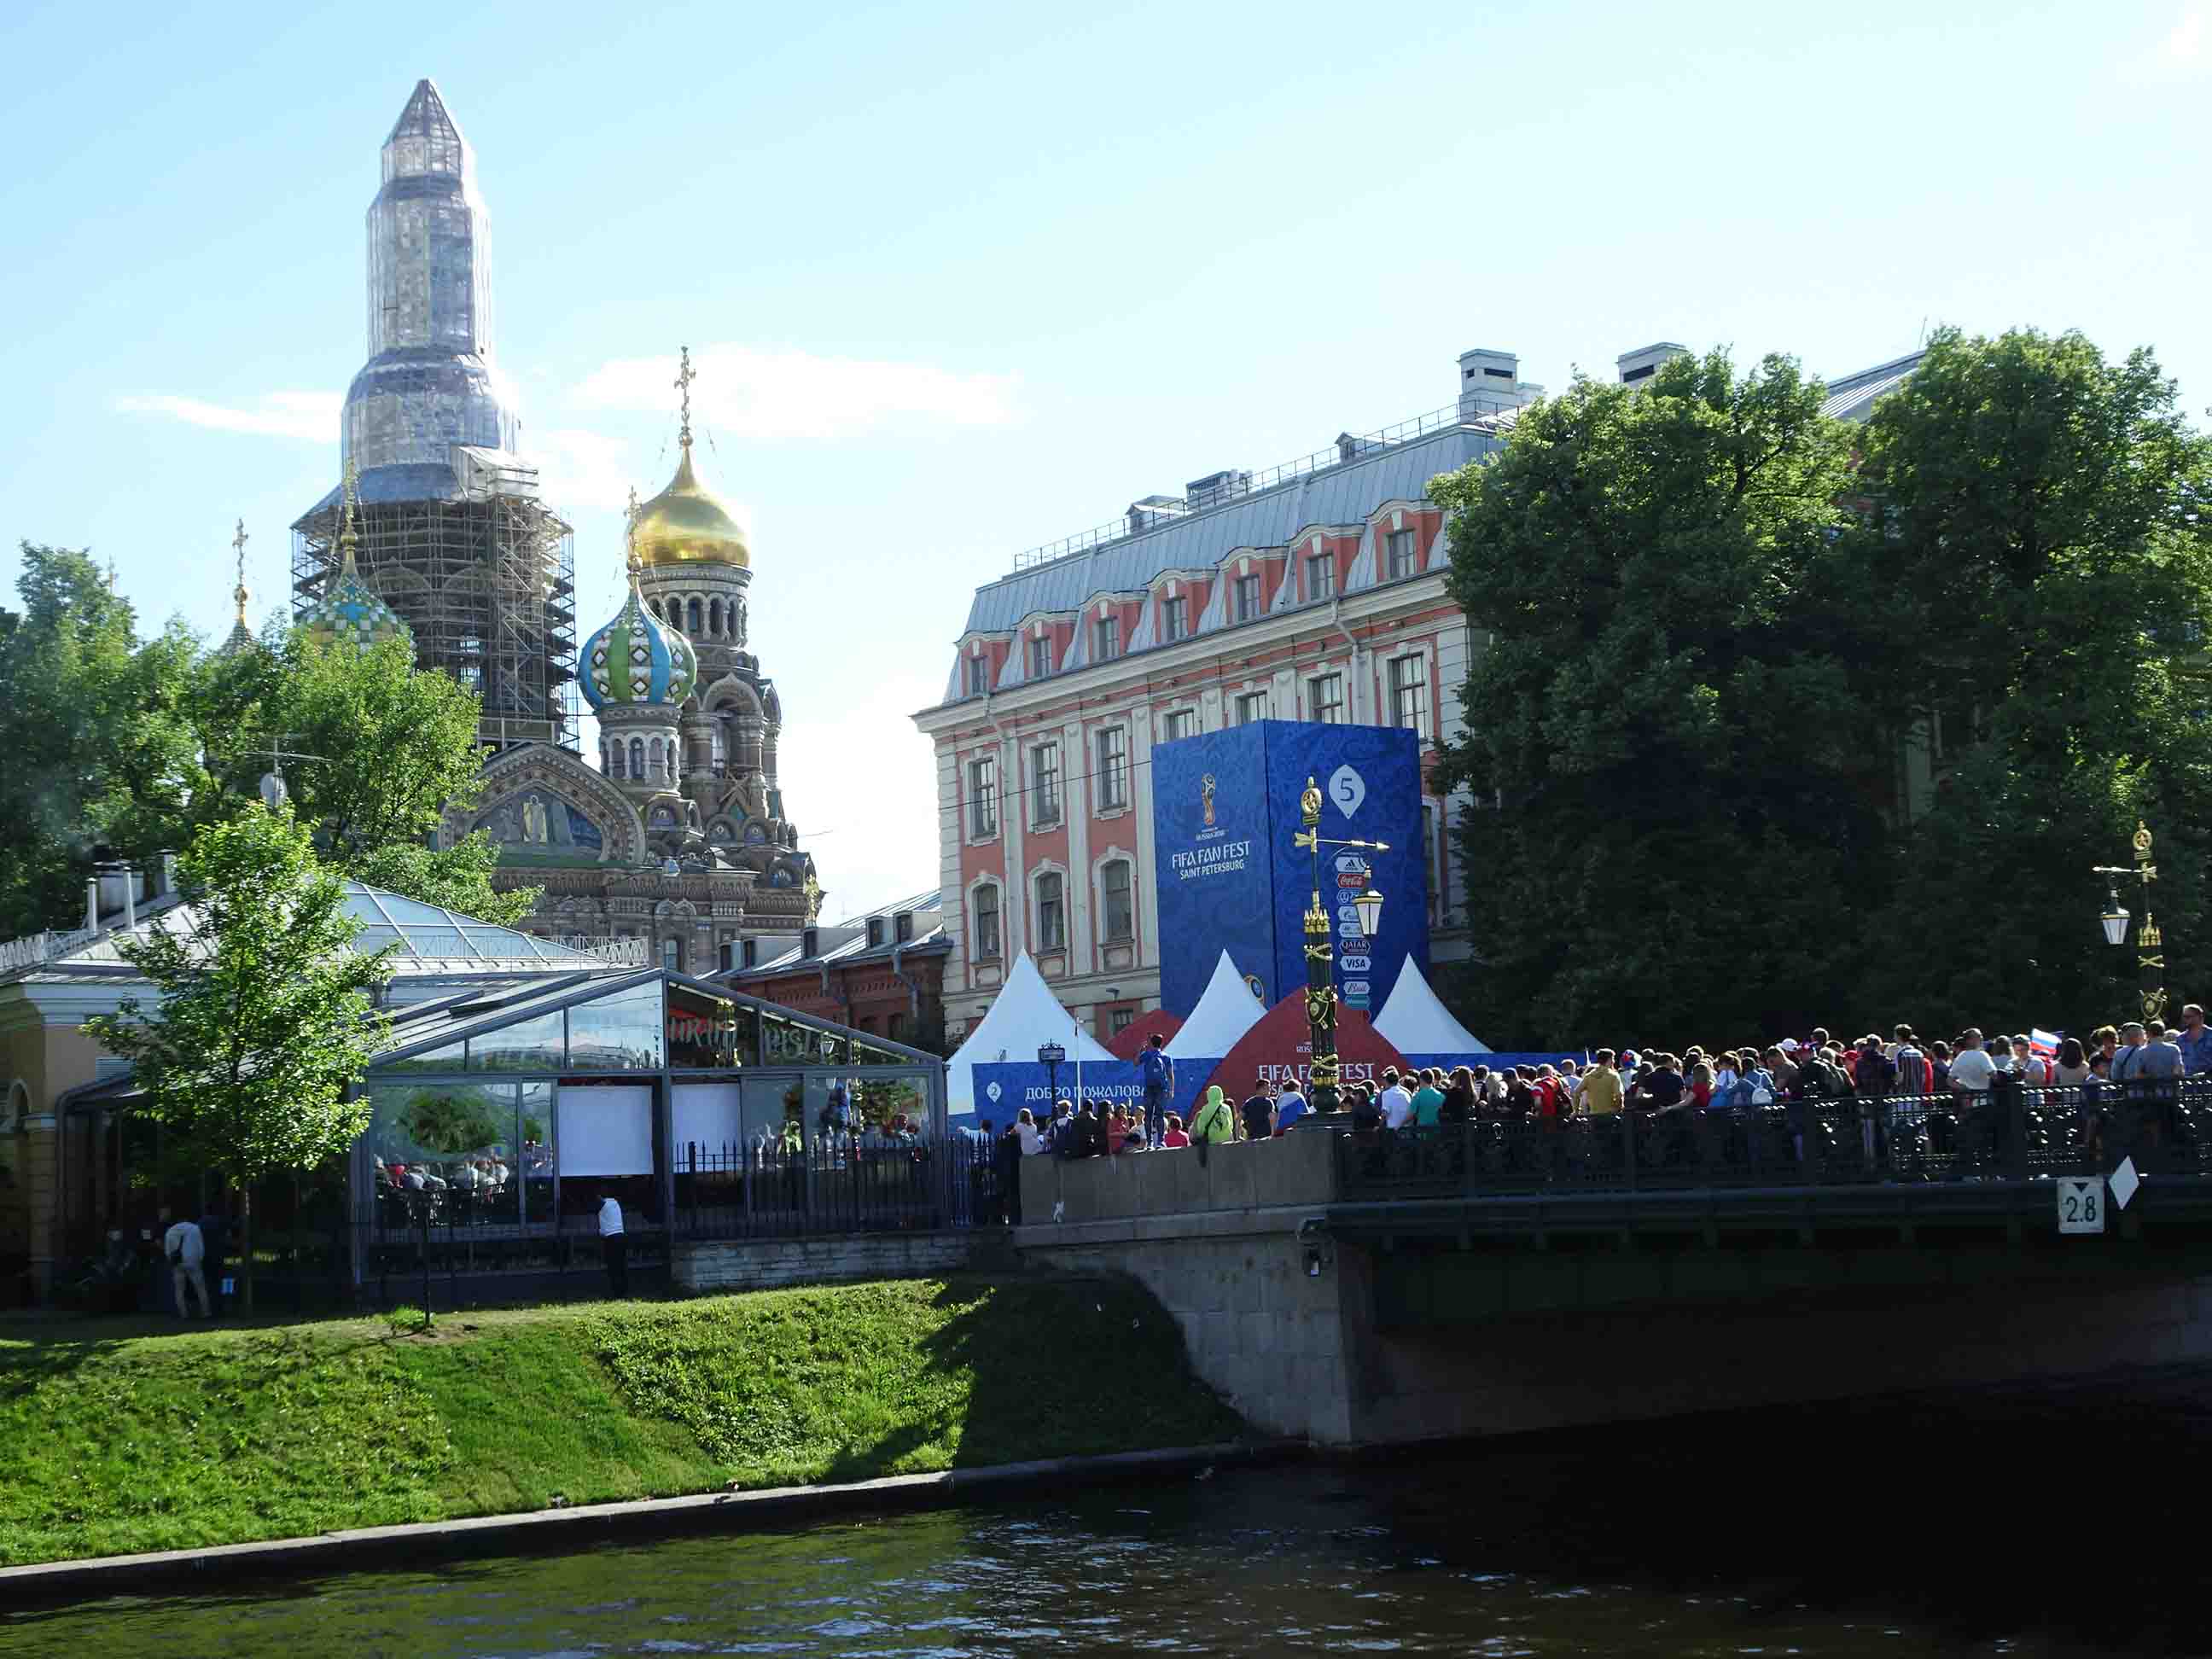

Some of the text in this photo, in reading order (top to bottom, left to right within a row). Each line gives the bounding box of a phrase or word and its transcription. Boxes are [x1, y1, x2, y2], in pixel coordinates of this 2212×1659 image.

[1340, 777, 1355, 802] 5
[1172, 841, 1250, 869] FIFA FAN FEST
[1179, 859, 1245, 880] SAINT PETERSBURG
[1342, 940, 1366, 951] QATAR
[1346, 958, 1366, 969] VISA
[1258, 1064, 1295, 1080] FIFA
[1338, 1063, 1376, 1080] FEST
[1025, 1086, 1072, 1102] ДОБРО
[2066, 1196, 2097, 1222] 2.8
